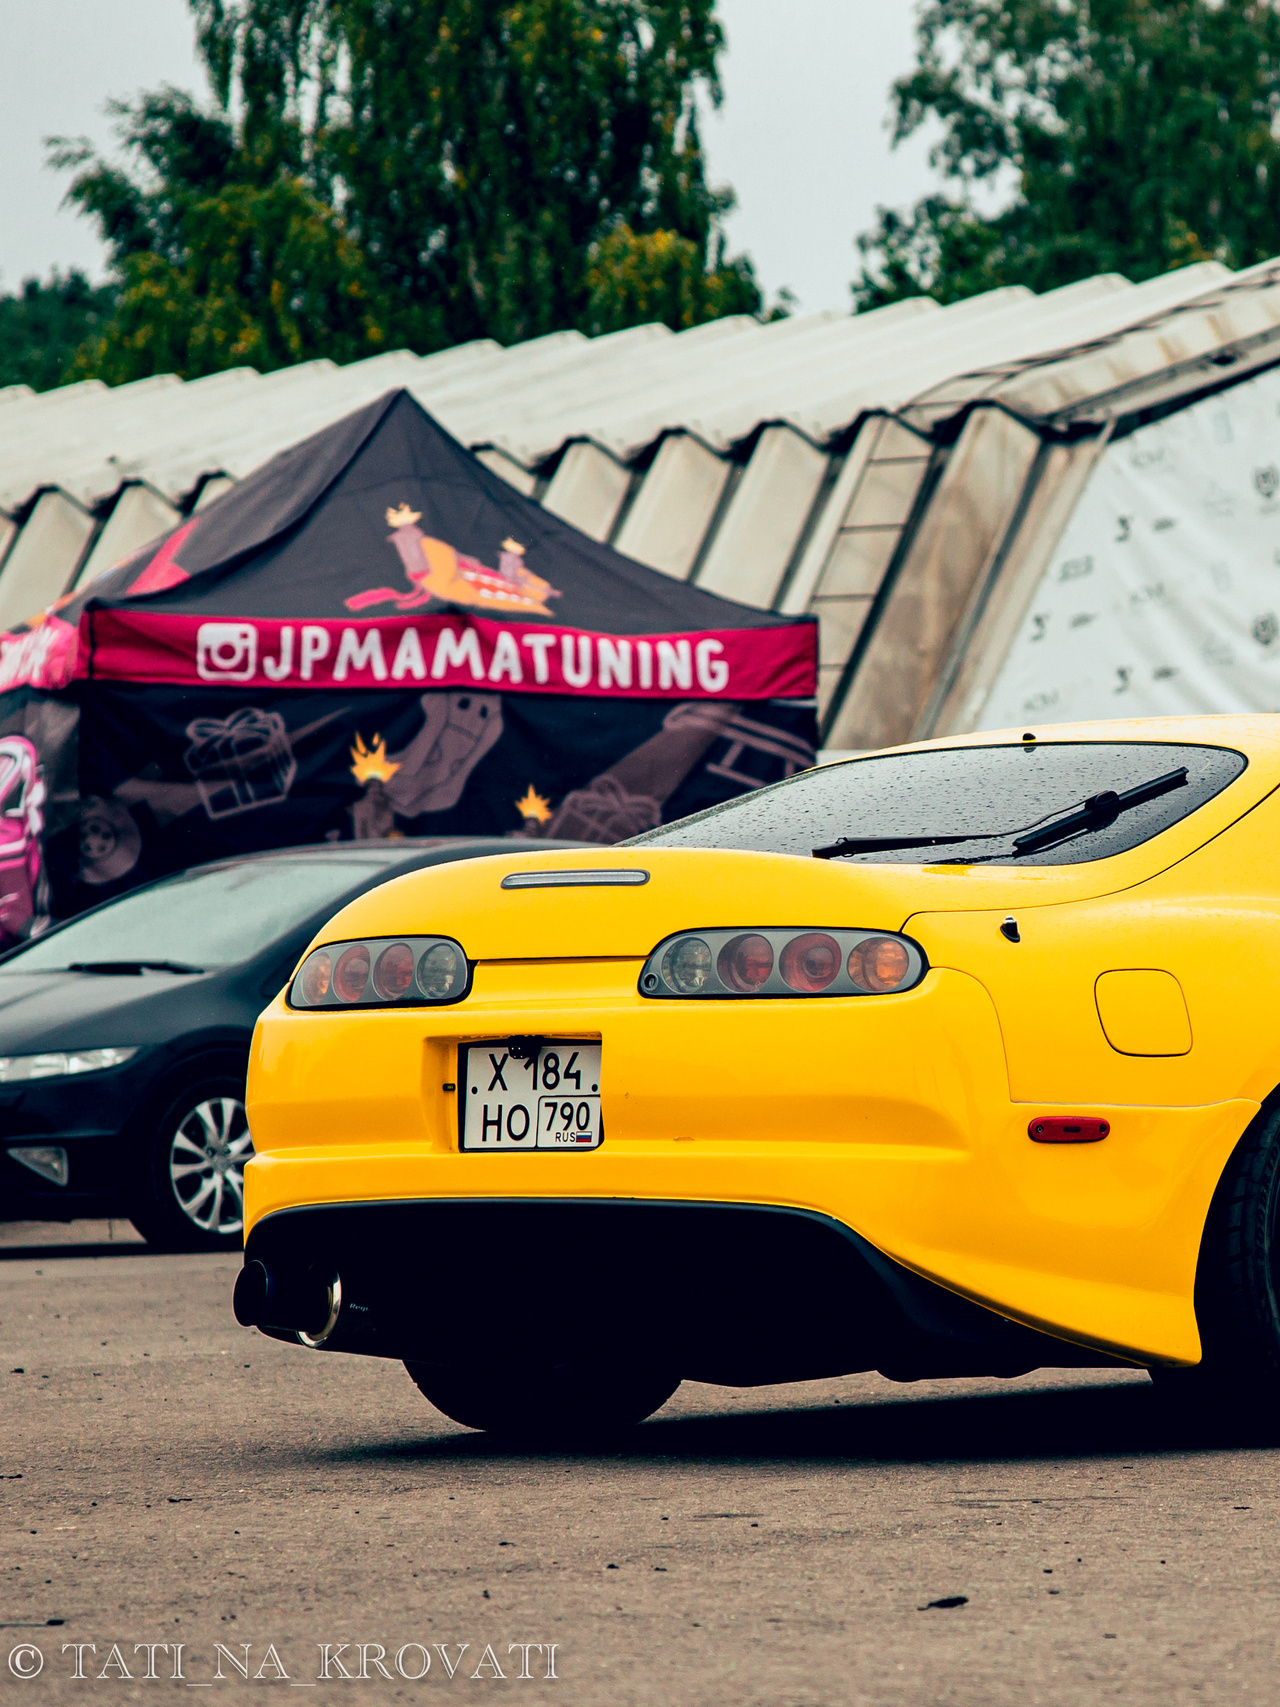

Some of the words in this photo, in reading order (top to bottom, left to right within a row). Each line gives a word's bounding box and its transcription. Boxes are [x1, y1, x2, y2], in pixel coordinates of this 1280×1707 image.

[262, 622, 730, 692] JPMAMATUNING
[523, 1052, 582, 1091] 184
[544, 1102, 590, 1131] 790
[555, 1132, 576, 1143] RUS
